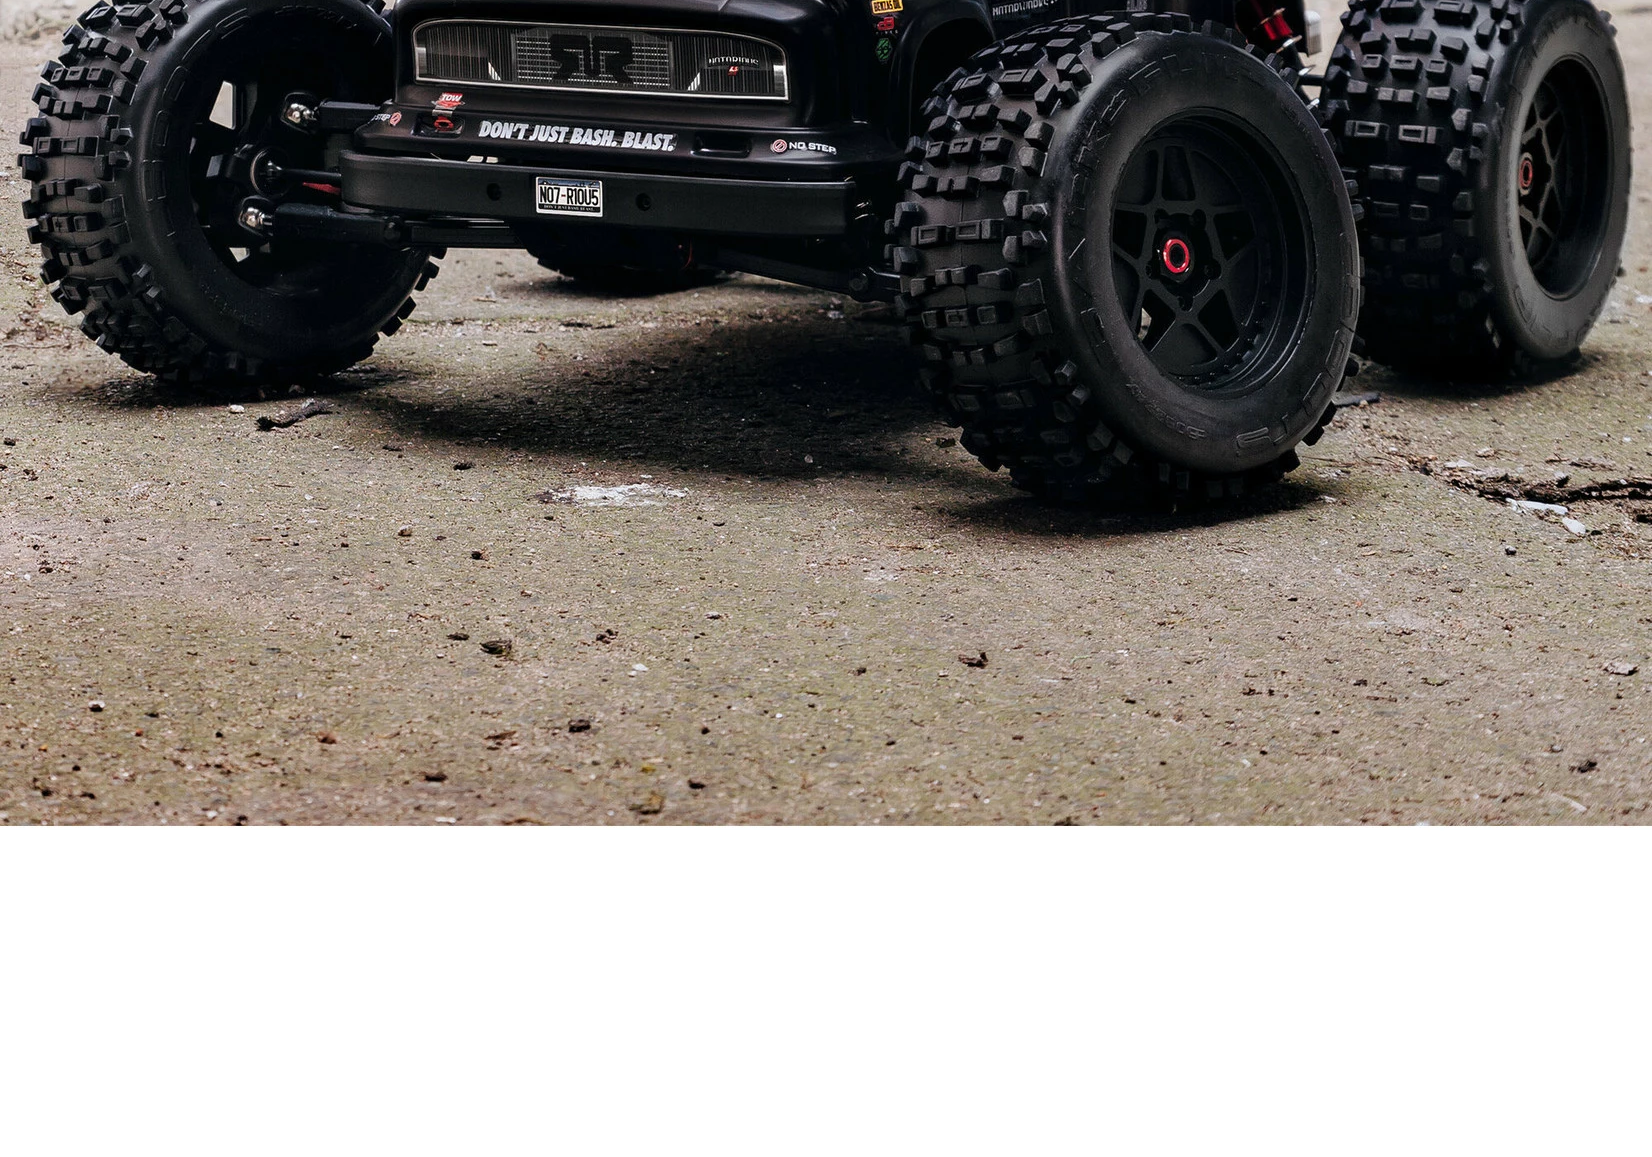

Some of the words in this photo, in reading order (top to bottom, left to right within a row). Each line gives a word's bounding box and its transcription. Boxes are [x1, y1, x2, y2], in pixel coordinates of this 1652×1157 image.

[441, 93, 463, 103] TOW
[478, 120, 529, 140] DON'T
[529, 124, 569, 143] JUST
[570, 128, 617, 146] BASH.
[620, 131, 676, 151] BLAST.
[788, 141, 808, 151] NO
[808, 142, 837, 155] STEP
